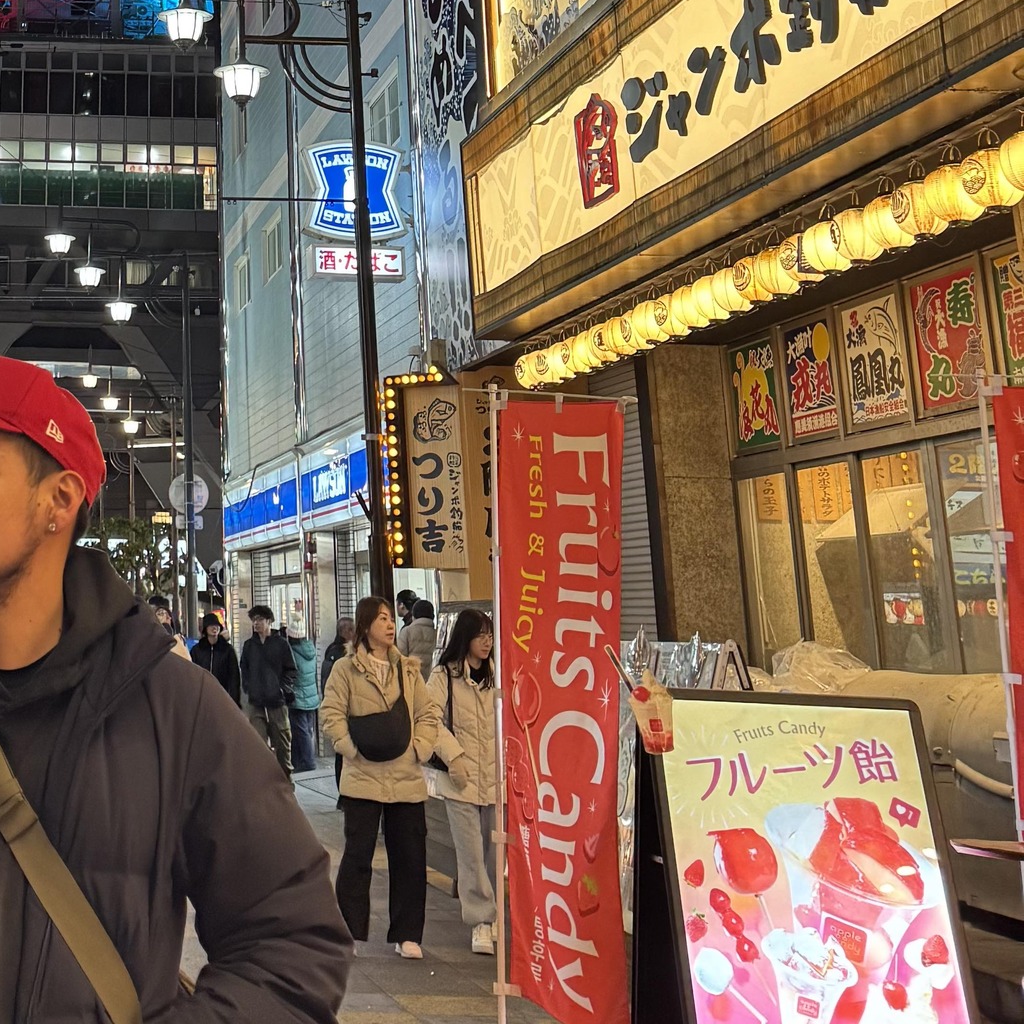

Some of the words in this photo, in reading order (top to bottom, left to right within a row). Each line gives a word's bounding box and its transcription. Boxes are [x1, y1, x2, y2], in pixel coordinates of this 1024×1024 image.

[321, 153, 389, 171] LAWON
[323, 210, 392, 225] STATON
[313, 464, 347, 504] LAWSON
[412, 452, 448, 553] つり吉
[528, 435, 548, 519] Fresh
[528, 532, 545, 556] &
[548, 432, 614, 692] Fruits
[511, 566, 546, 653] Juicy
[733, 725, 775, 744] Fruits
[778, 720, 826, 738] Candy
[685, 738, 898, 802] フルーツ飴
[538, 709, 606, 1015] Candy
